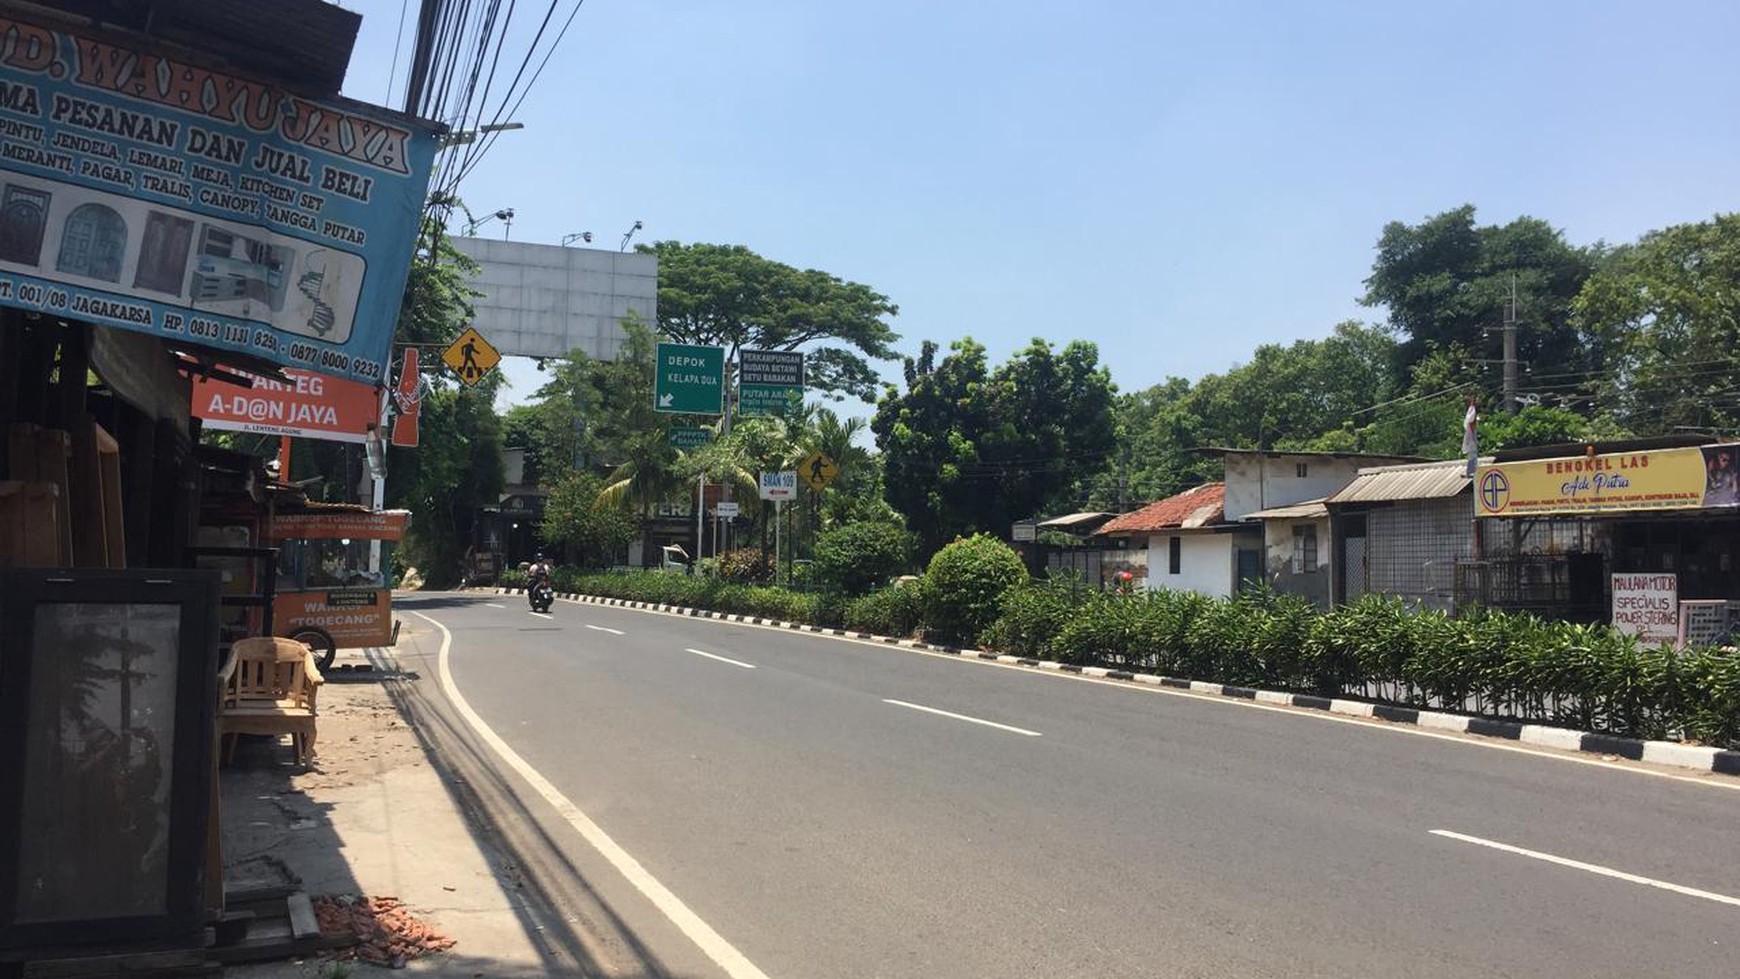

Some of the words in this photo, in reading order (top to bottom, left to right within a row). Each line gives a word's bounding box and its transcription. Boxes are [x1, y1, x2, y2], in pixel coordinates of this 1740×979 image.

[72, 36, 284, 131] WAHYU
[281, 97, 411, 175] JAYA
[52, 95, 178, 147] PESANAN
[187, 128, 246, 166] DAN
[254, 144, 311, 183] JUAL
[321, 166, 372, 201] BELI
[0, 119, 45, 145] PINTU,
[53, 132, 122, 163] JENDELA,
[129, 149, 185, 177] LEMARI,
[192, 164, 234, 190] MEJA,
[240, 176, 296, 202] KITCHEN
[299, 193, 325, 212] SET
[2, 142, 74, 175] MERANTI,
[80, 160, 135, 189] PAGAR,
[142, 174, 193, 203] TRALIS,
[199, 189, 261, 216] CANOPY,
[266, 204, 317, 232] TANGGA
[323, 222, 367, 245] PUTAR
[19, 285, 66, 309] 001/08
[72, 295, 152, 326] JAGAKARSA
[163, 313, 184, 332] HP.
[190, 319, 218, 338] 0813
[321, 351, 348, 371] 8000
[353, 359, 382, 379] 9232
[667, 356, 705, 368] DEPOK
[743, 363, 769, 372] BUDAYA
[771, 364, 798, 373] BETAWI
[668, 372, 700, 384] KELAPA
[701, 376, 718, 385] DUA
[743, 373, 761, 382] SETU
[208, 394, 284, 421] A-D@N
[287, 403, 339, 426] JAYA
[1546, 457, 1612, 474] BENGKEL
[1621, 455, 1650, 469] LAS
[763, 474, 781, 487] SMAN
